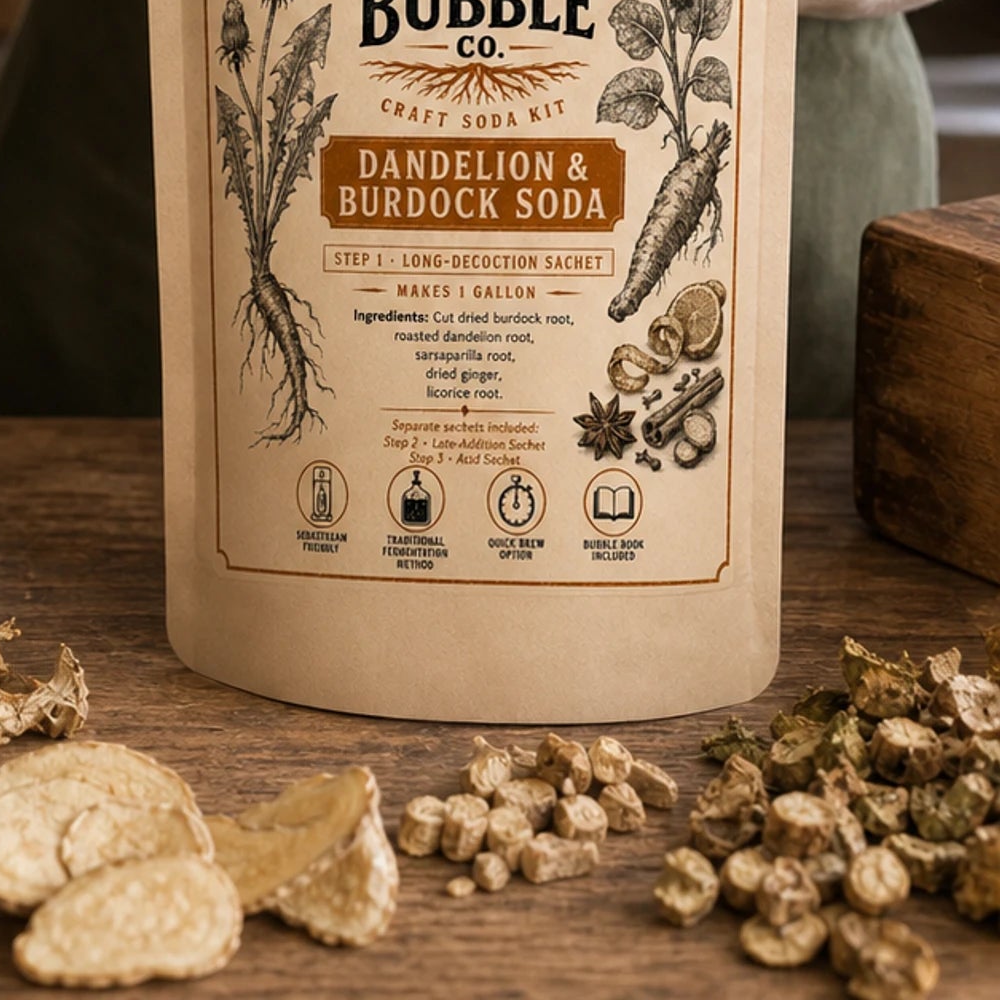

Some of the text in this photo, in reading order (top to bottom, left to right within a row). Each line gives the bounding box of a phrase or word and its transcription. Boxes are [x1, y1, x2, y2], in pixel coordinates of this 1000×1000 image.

[457, 36, 504, 58] CO.
[381, 96, 564, 129] CRAFT SODA KIT
[359, 149, 588, 181] DANDELION &
[339, 186, 606, 219] BURDOCK SODA
[335, 252, 603, 270] STEP 1 LONG-DECOCTION SACHET
[397, 284, 535, 299] MAKES 1 GALLON
[354, 309, 574, 326] Ingredients: Cut dried burdock root,
[394, 330, 534, 344] roasted dandelion root,
[415, 349, 515, 364] sarsaparilla root,
[426, 367, 502, 384] dried ginger,
[427, 386, 470, 399] licorice
